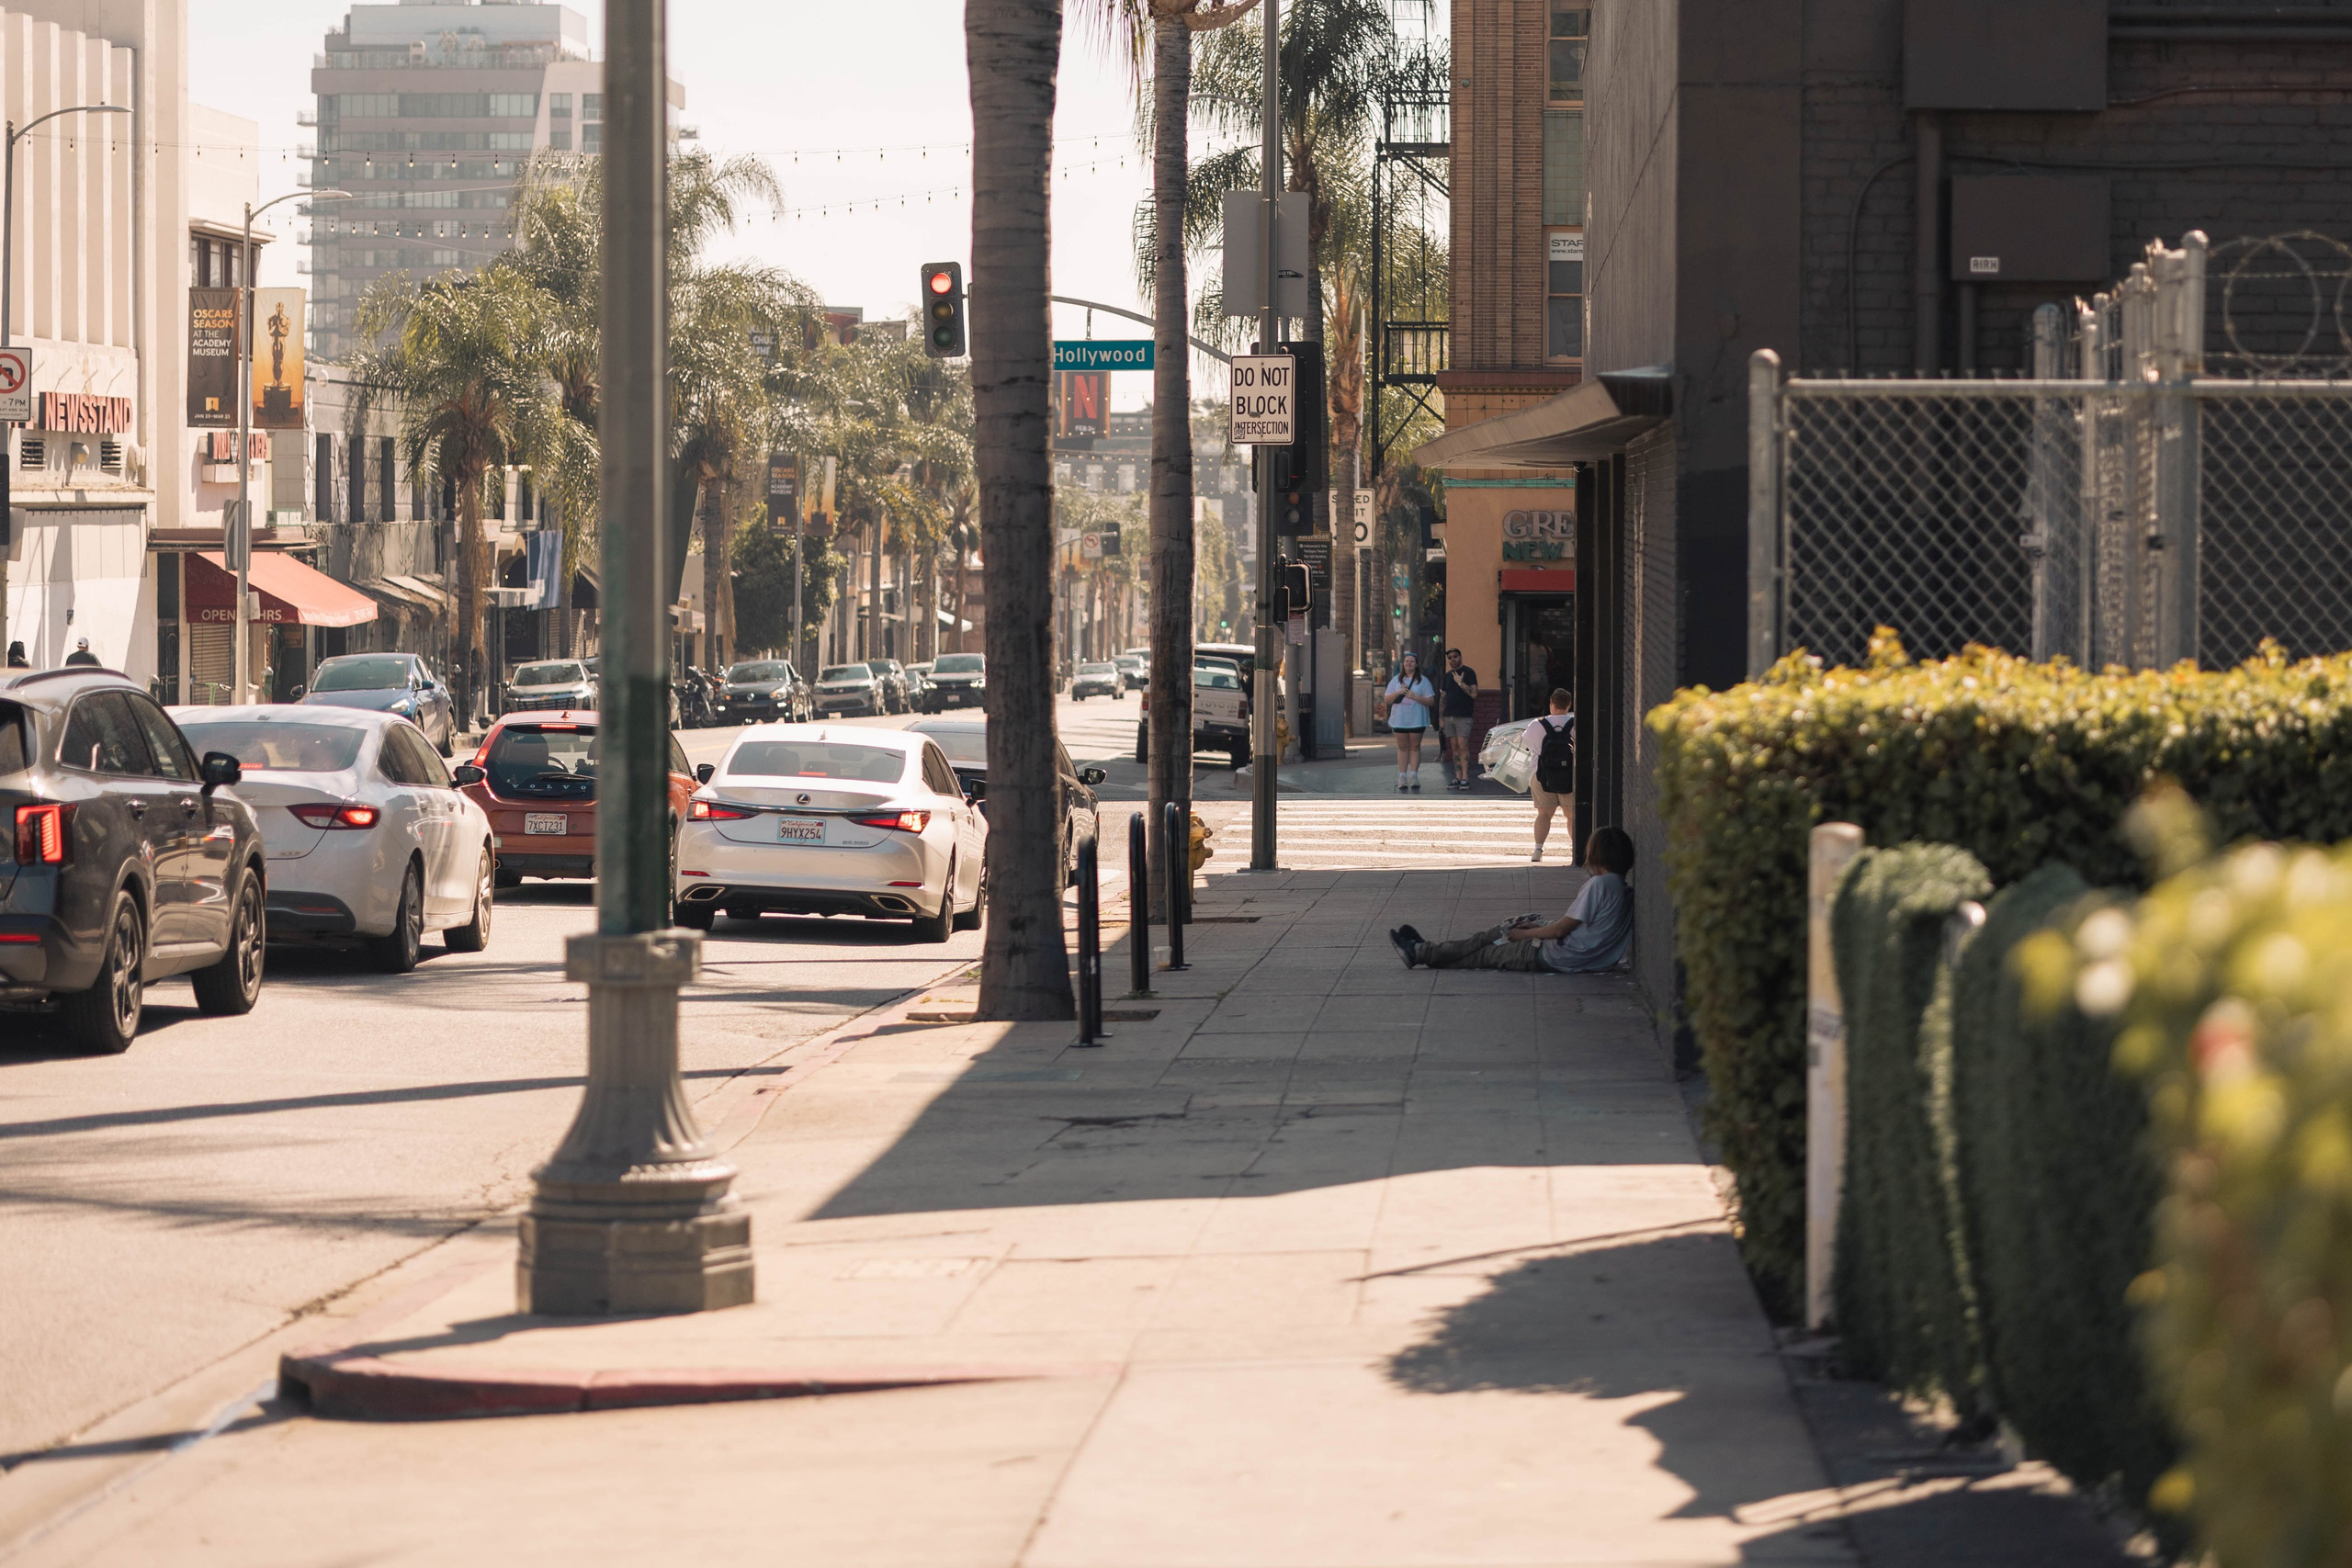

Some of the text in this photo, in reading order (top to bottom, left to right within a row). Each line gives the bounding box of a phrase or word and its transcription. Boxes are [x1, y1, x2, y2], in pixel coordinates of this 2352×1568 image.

[193, 309, 233, 319] OSCARS
[193, 320, 234, 329] SEASON
[193, 330, 220, 338] AT THE
[192, 339, 232, 347] ACADEMY
[193, 348, 229, 356] MUSEUM
[1053, 347, 1146, 367] Hollywood
[1234, 367, 1290, 387] DO NOT
[8, 398, 26, 407] 7 PM
[1073, 375, 1098, 419] N
[1236, 396, 1287, 415] BLOCK
[45, 391, 133, 434] NEWSSTAND
[1331, 495, 1370, 503] SED
[1502, 540, 1564, 562] NEW
[201, 609, 282, 621] OPEN HRS
[528, 820, 563, 831] 7XCT231
[780, 827, 821, 840] 9HYX254
